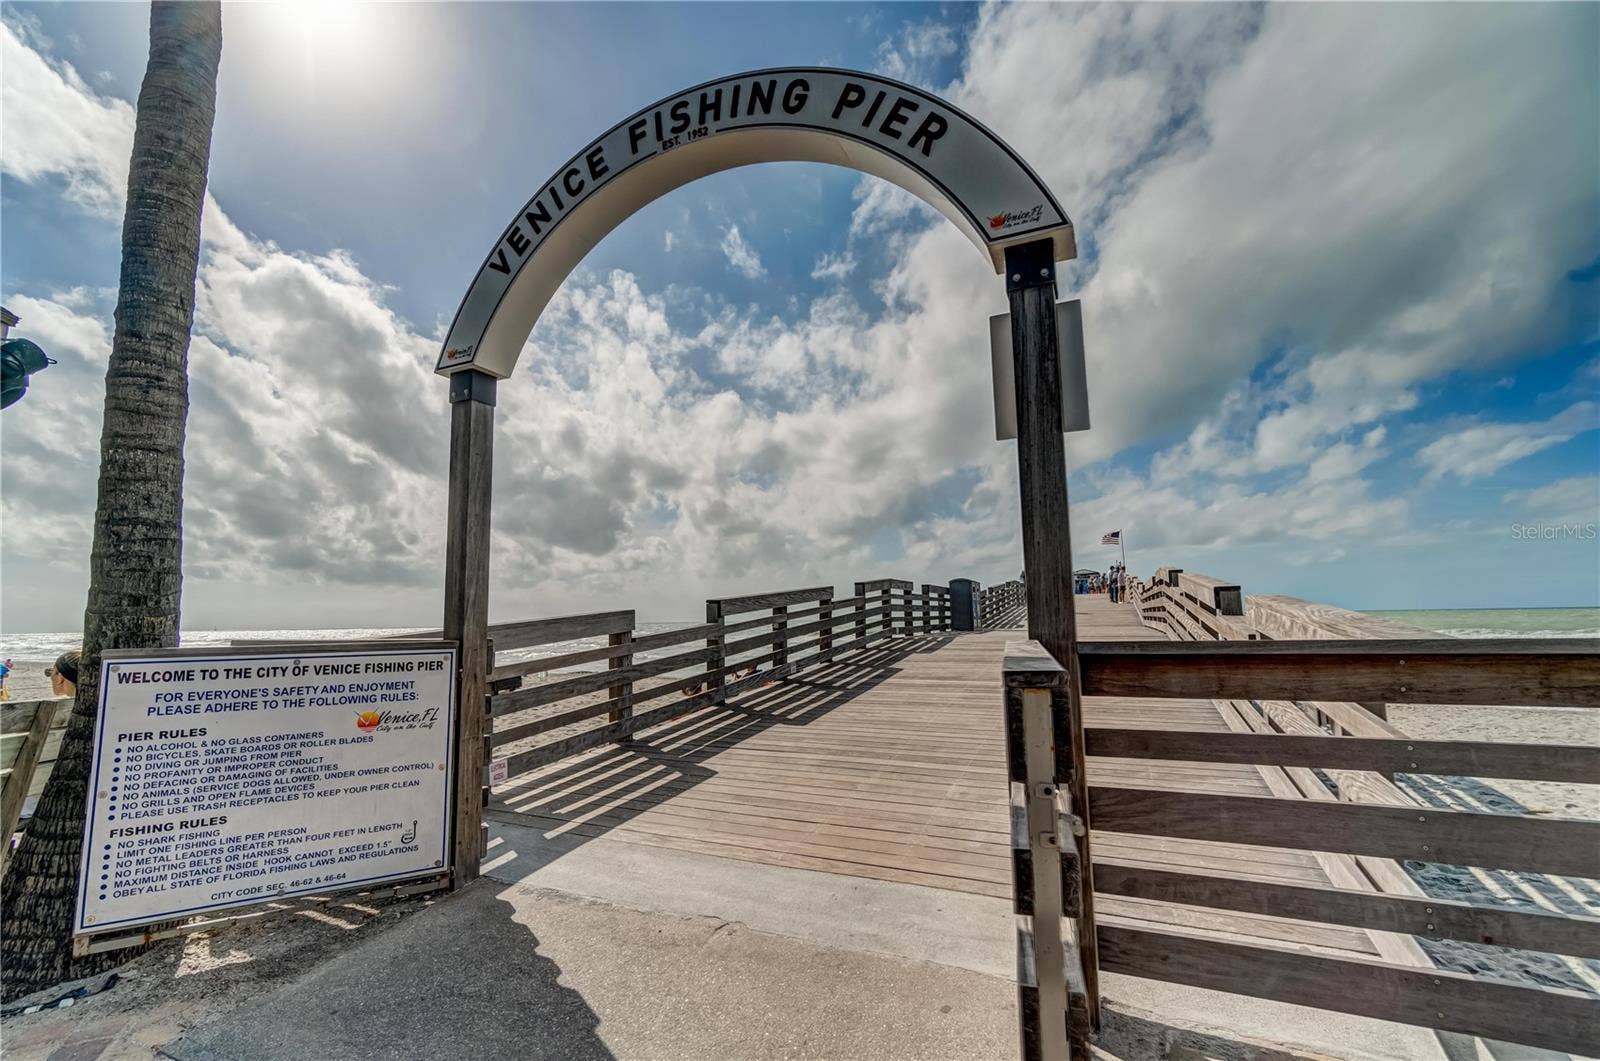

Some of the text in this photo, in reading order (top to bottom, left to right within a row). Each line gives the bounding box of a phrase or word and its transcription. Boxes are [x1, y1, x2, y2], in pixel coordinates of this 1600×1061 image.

[662, 126, 708, 150] EST. 1952
[489, 79, 948, 276] VENICE FISHING PIER
[118, 661, 443, 684] WELCOME TO THE CITY OF VENICE FISHING PIER
[147, 692, 419, 716] PLEASE ADHERE TO THE FOLLOWING RULES:
[156, 681, 415, 702] FOR EVERYONE'S SAFETY AND ENJOYMENT
[118, 728, 207, 742] PIER RULES
[146, 742, 197, 752] ALCOHOL
[229, 736, 261, 745] GLASS
[265, 732, 324, 742] CONTAINERS
[205, 747, 237, 757] SKATE
[240, 743, 281, 752] BOARDS
[300, 739, 336, 748] ROLLER
[339, 736, 373, 745] BLADES
[125, 757, 324, 782] NO PROFANITY OR IMPROPER CONDUCT
[126, 764, 141, 772] NO
[145, 761, 181, 771] DIVING
[185, 759, 199, 767] OR
[202, 755, 247, 765] JUMPING
[251, 752, 278, 761] FROM
[123, 793, 139, 801] NO
[142, 788, 190, 799] ANIMALS
[193, 782, 240, 794] (SERVICE
[243, 780, 270, 788] DOGS
[325, 769, 355, 779] UNDER
[358, 766, 389, 776] OWNER
[392, 762, 434, 773] CONTROL)
[124, 783, 140, 791] NO
[143, 778, 197, 790] DEFACING
[219, 770, 271, 782] DAMAGING
[290, 764, 338, 774] FACILITIES
[121, 809, 164, 820] PLEASE
[168, 806, 188, 814] USE
[193, 802, 226, 812] TRASH
[229, 794, 299, 807] RECEPTACLES
[317, 789, 341, 797] KEEP
[344, 786, 368, 794] YOUR
[370, 783, 389, 791] PIER
[392, 780, 420, 789] CLEAN
[122, 783, 315, 810] NO GRILLS AND OPEN FLAME DEVICES
[110, 816, 227, 838] FISHING RULES
[118, 829, 220, 849] NO SHARK FISHING
[116, 860, 132, 868] NO
[136, 856, 171, 866] METAL
[176, 848, 224, 861] LEADERS
[228, 841, 274, 853] GREATER
[278, 837, 302, 845] THAN
[305, 832, 329, 841] FOUR
[333, 829, 355, 837] FEET
[369, 823, 402, 833] LENGTH
[117, 827, 307, 859] LIMIT ONE FISHING LINE PER PERSON
[113, 888, 143, 898] OBEY
[146, 884, 166, 892] ALL
[170, 879, 202, 889] STATE
[223, 869, 266, 881] FLORIDA
[270, 862, 307, 874] FISHING
[310, 857, 336, 867] LAWS
[338, 854, 356, 862] AND
[359, 845, 419, 860] REGULATIONS
[114, 875, 168, 888] MAXIMUM
[171, 867, 222, 880] DISTANCE
[226, 861, 258, 871] INSIDE
[264, 857, 292, 866] HOOK
[295, 850, 333, 861] CANNOT
[339, 843, 374, 854] EXCEED
[115, 870, 131, 879] NO
[135, 863, 186, 875] FIGHTING
[190, 858, 221, 868] BELTS
[243, 847, 289, 860] HARNESS
[211, 891, 233, 900] CITY
[236, 886, 264, 896] CODE
[266, 883, 287, 891] SEC.
[290, 878, 313, 887] 46-62
[324, 873, 346, 882] 46-64
